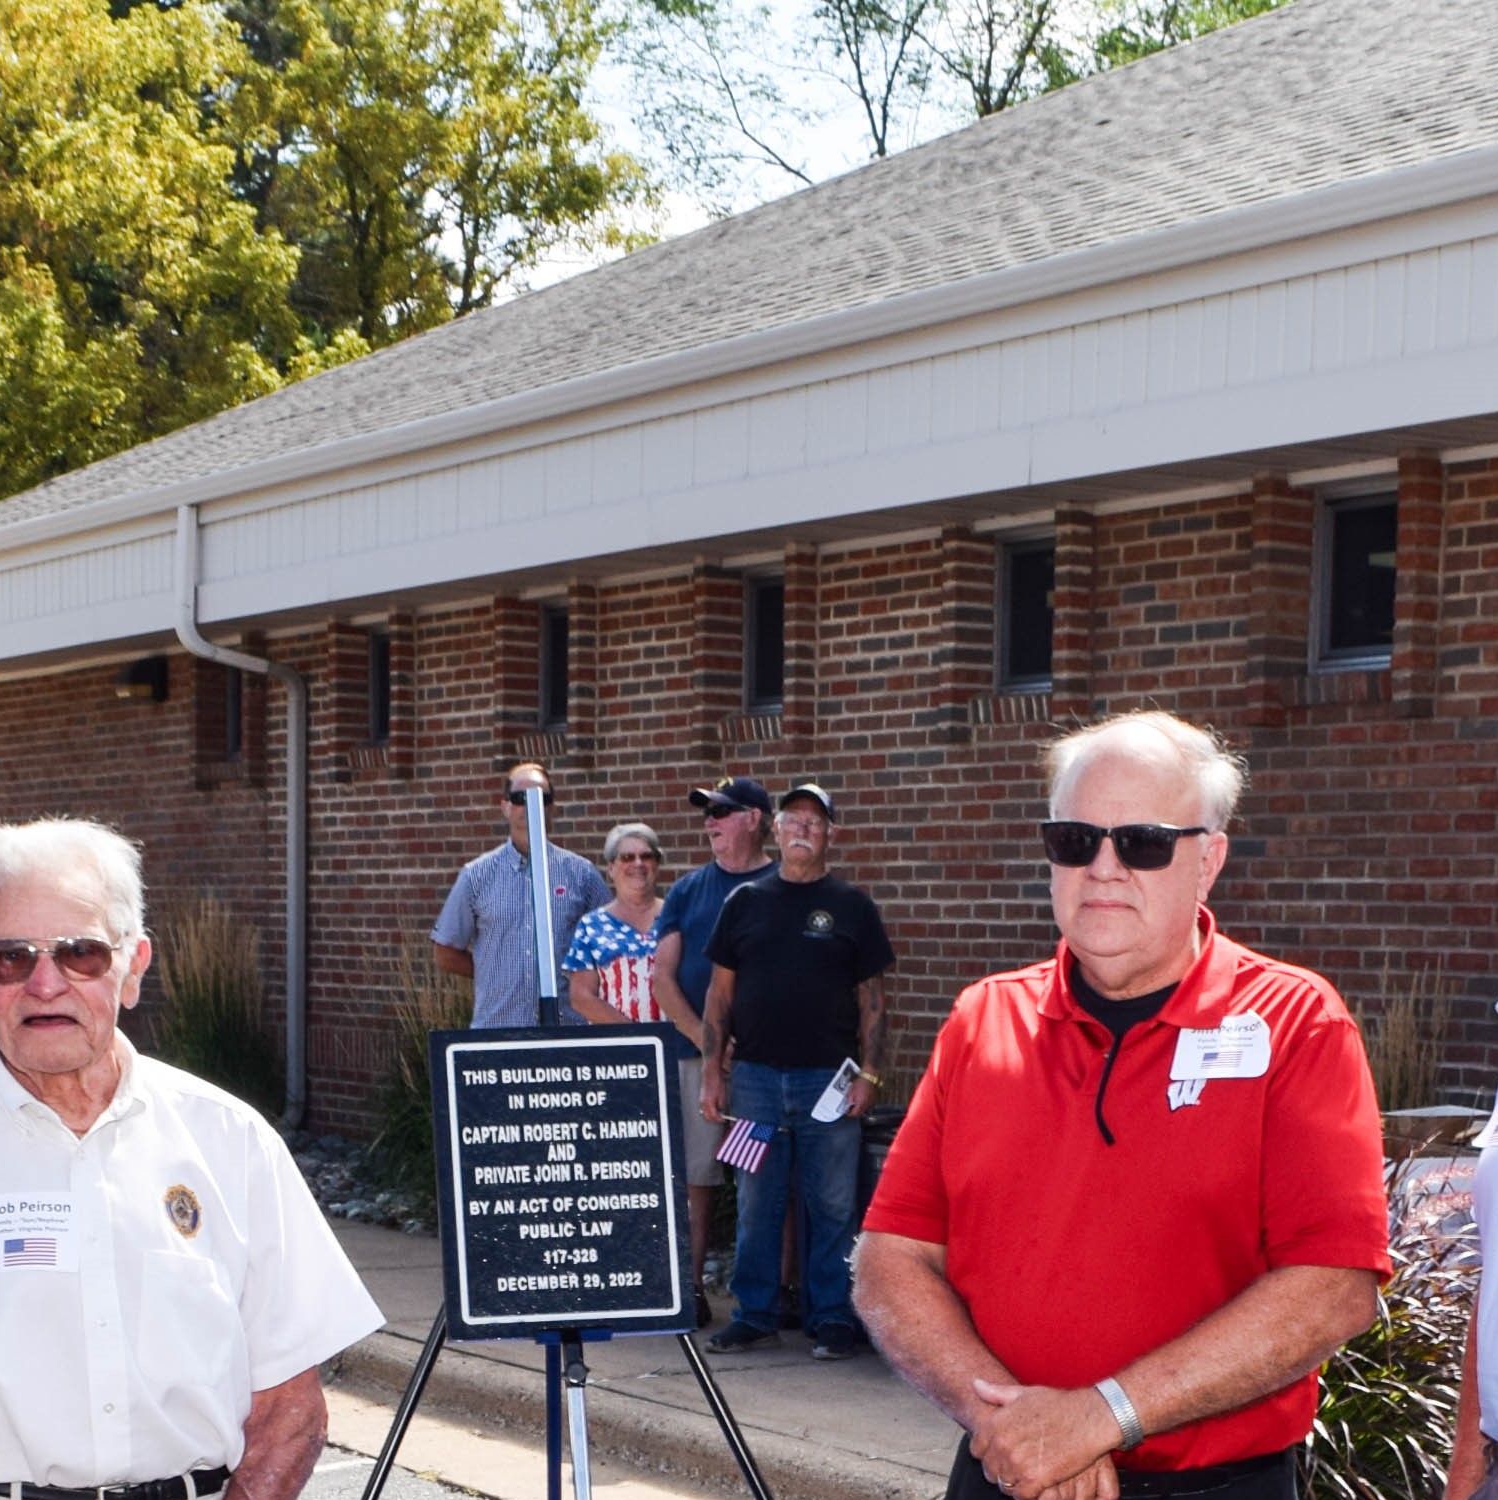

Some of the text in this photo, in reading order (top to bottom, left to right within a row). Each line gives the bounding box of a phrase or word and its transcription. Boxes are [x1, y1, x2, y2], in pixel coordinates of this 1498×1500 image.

[463, 1065, 648, 1085] THIS BUILDING IS NAMED
[509, 1092, 606, 1110] IN HONOR OF
[462, 1121, 658, 1144] CAPTAIN ROBERT C. HARMON
[548, 1144, 576, 1161] AND
[475, 1161, 650, 1184] PRIVATE JOHN R. PEIRSON
[19, 1201, 71, 1213] Peirson
[469, 1194, 658, 1216] BY AN ACT OF CONGRESS
[520, 1222, 613, 1239] PUBLIC LAW
[543, 1249, 598, 1264] 117-328
[498, 1273, 642, 1291] DECEMBER 29, 2022
